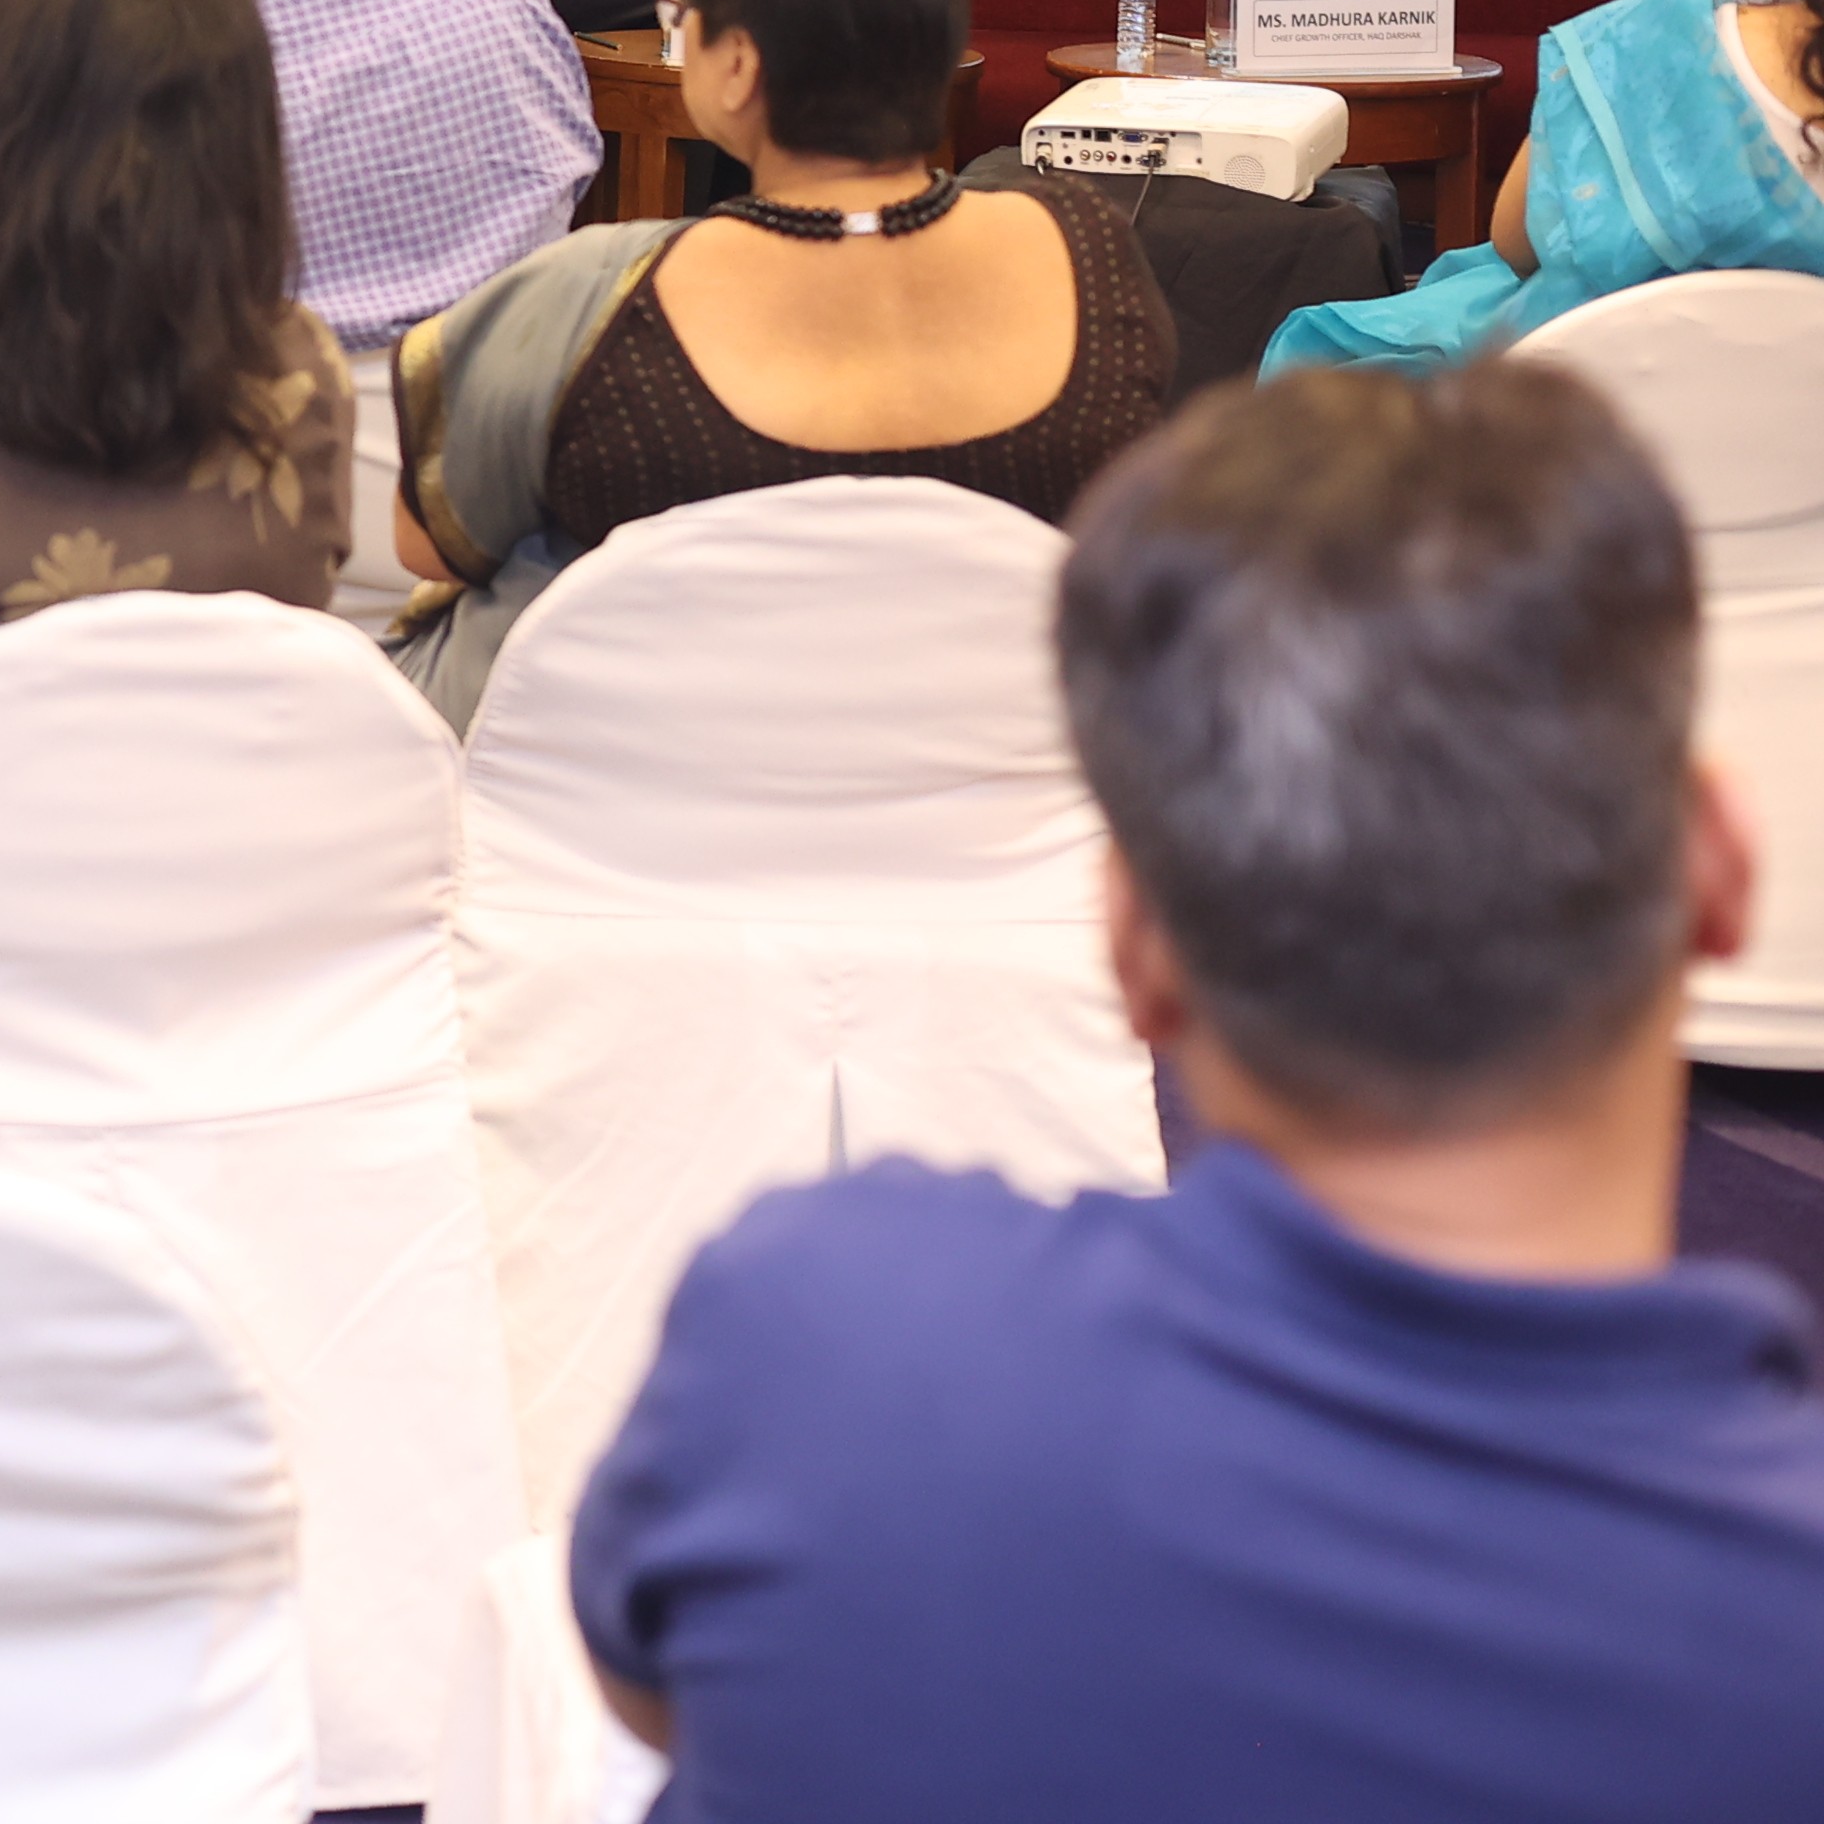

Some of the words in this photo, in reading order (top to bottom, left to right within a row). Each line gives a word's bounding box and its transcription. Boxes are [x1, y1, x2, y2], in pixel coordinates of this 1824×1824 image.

[1258, 15, 1286, 27] MS.
[1292, 13, 1373, 26] MADHURA
[1378, 11, 1436, 25] KARNIK
